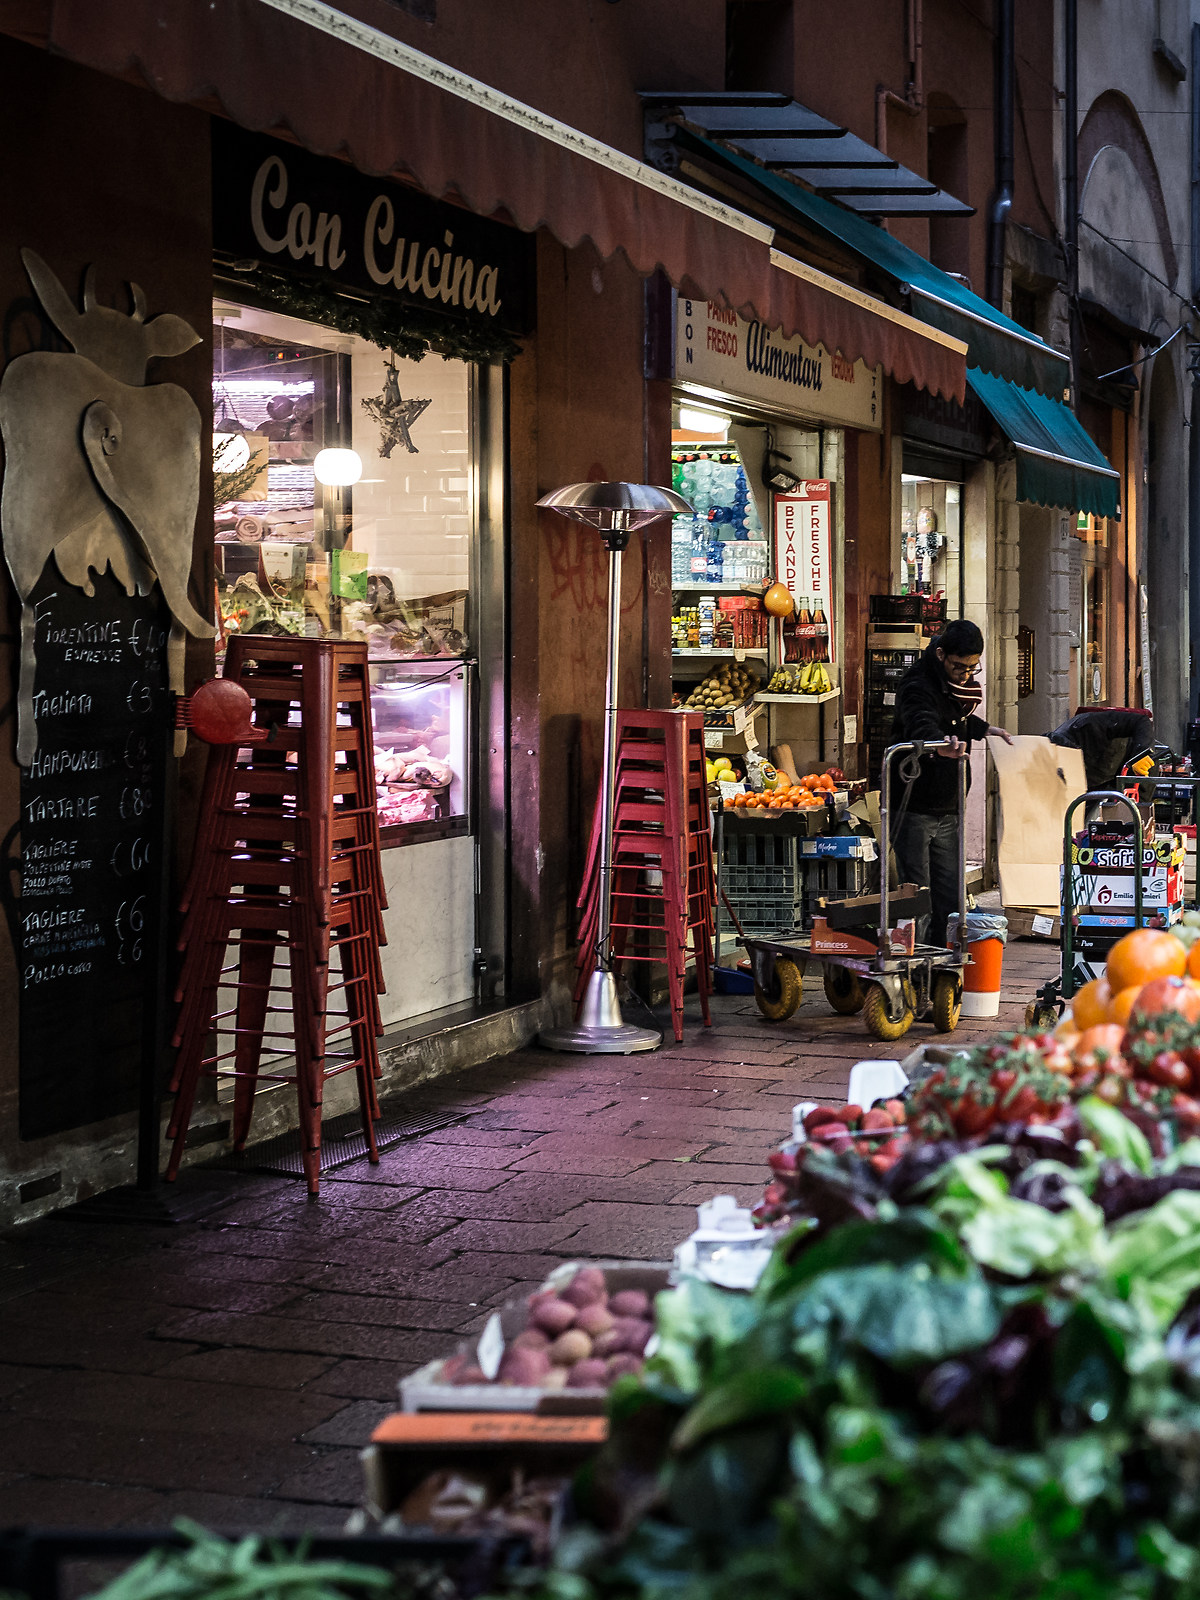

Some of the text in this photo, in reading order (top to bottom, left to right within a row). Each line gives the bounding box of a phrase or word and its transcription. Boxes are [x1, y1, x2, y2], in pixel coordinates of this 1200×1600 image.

[251, 155, 501, 317] Con Cucina
[707, 326, 738, 358] FRESCO
[746, 320, 823, 391] Alimentari
[785, 505, 796, 592] BEVANDE
[810, 504, 821, 591] FRESCHE
[33, 690, 92, 720] TAGLIATA
[25, 795, 100, 824] TARTARE
[22, 903, 86, 932] TAGLIERE
[815, 940, 849, 949] Princess
